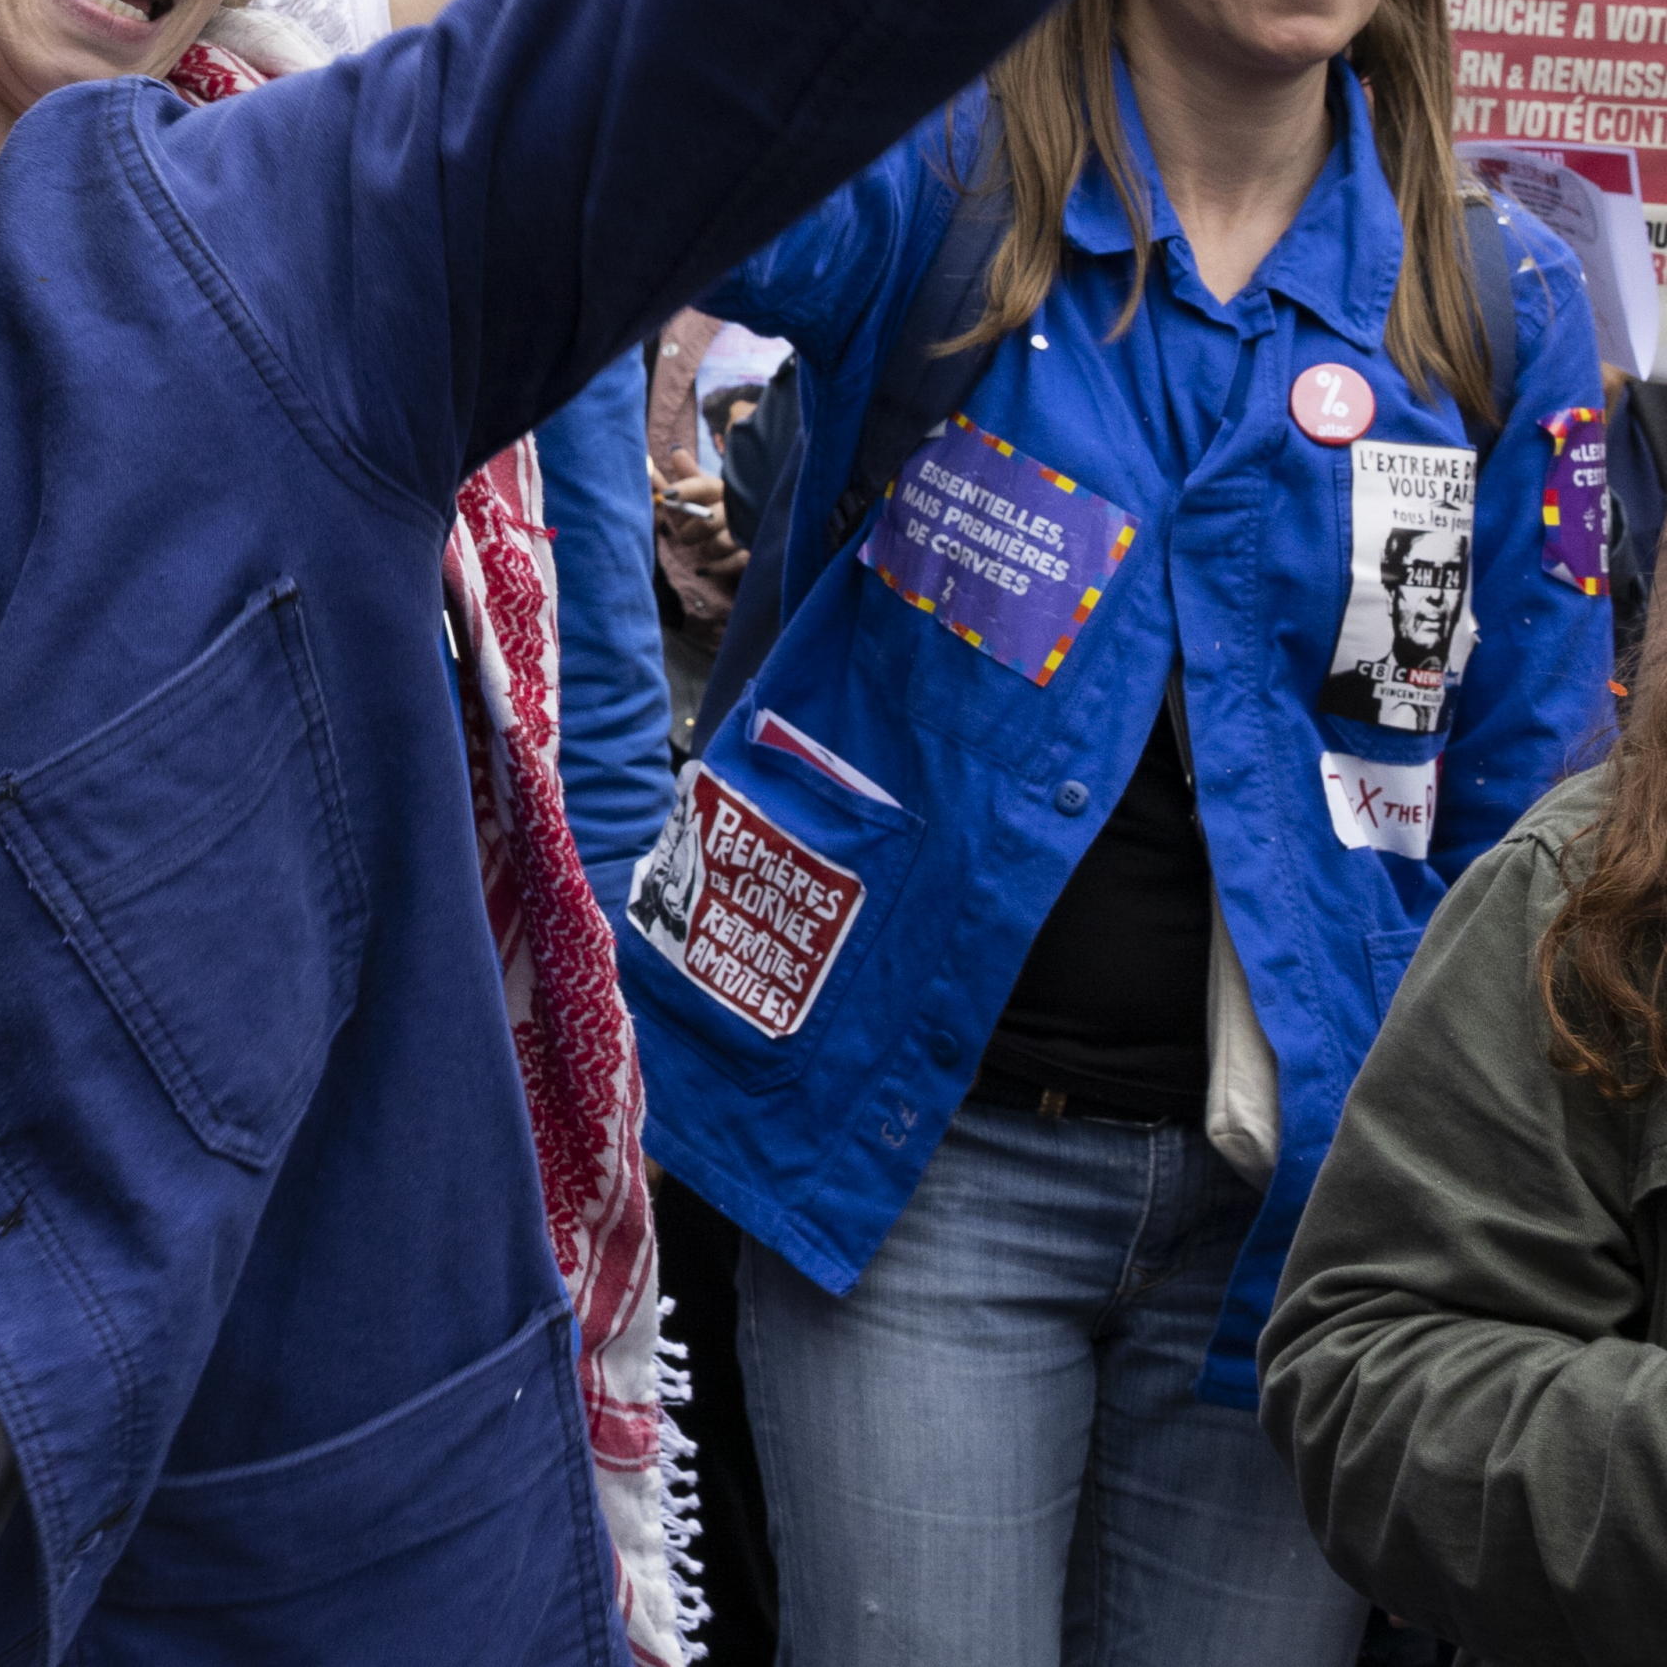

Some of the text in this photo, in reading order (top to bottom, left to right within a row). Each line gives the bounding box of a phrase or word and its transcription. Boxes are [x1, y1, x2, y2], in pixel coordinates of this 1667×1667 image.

[1573, 3, 1596, 40] A
[1458, 50, 1505, 88] RN
[1507, 63, 1524, 90] &
[1451, 96, 1498, 134] NT
[1504, 96, 1585, 139] VOTÉ
[1317, 422, 1354, 438] attac
[1360, 450, 1459, 480] L'EXTREME
[1388, 476, 1437, 501] VOUS
[919, 459, 1066, 552] ESSENTIELLES,
[1392, 509, 1425, 526] tous
[1430, 508, 1448, 528] les
[901, 482, 1071, 582] MAIS PREMIÈRES
[905, 517, 1032, 597] DE CORVÉES
[1405, 567, 1433, 587] 24H
[1444, 570, 1460, 588] 24
[1379, 686, 1420, 701] VINCENT
[1383, 800, 1423, 825] THE
[709, 869, 731, 894] DE
[686, 935, 797, 1029] AMPUTÉES
